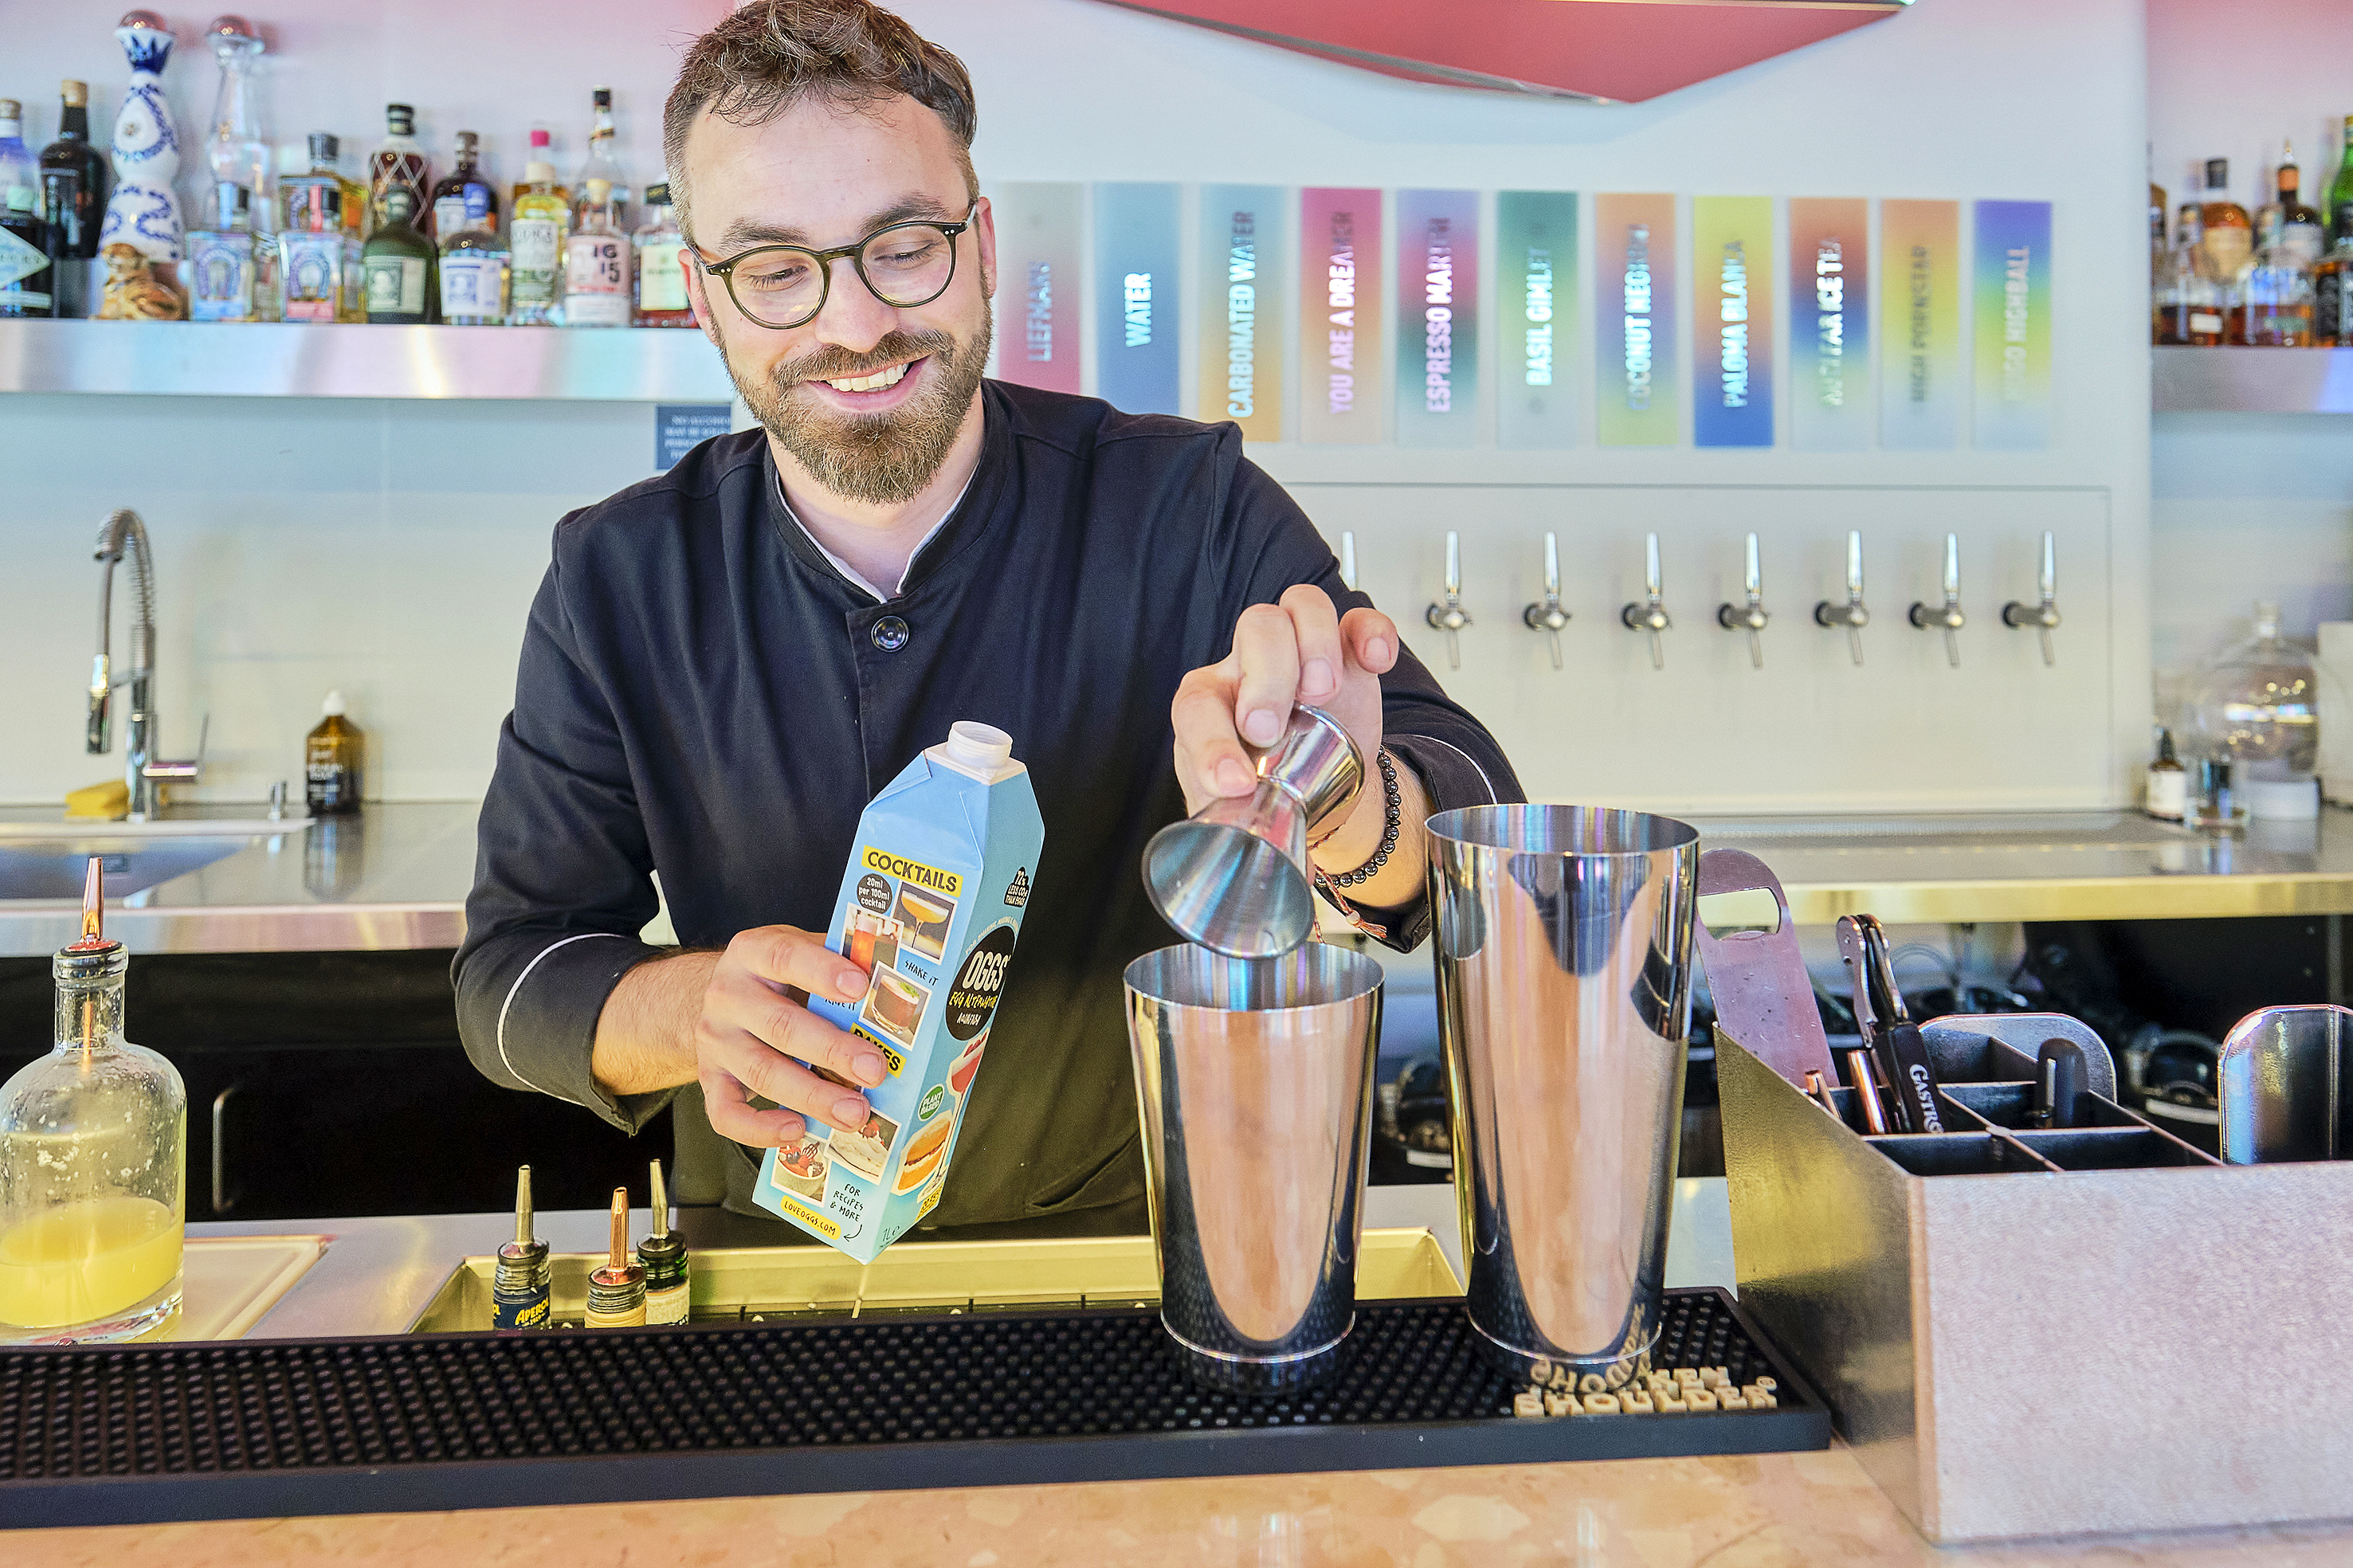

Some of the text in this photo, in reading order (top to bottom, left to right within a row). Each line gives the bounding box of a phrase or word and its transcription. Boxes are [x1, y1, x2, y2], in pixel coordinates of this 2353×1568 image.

[1124, 272, 1152, 347] WATER
[1816, 276, 1844, 312] ICE
[1228, 211, 1257, 417] CARBONATED WATER
[1329, 310, 1355, 327] A
[1525, 246, 1552, 386] BASIL GIMLET
[1329, 329, 1355, 370] ARE
[1426, 306, 1452, 413] ESPRESSO
[1625, 314, 1652, 411] COCONUT
[1721, 323, 1748, 408] PALOMA
[1328, 373, 1355, 414] YOU
[866, 876, 884, 889] 20ml
[868, 851, 957, 892] COCKTAILS
[858, 886, 890, 901] per 100ml
[861, 897, 886, 910] cocktail
[904, 959, 928, 980] SHAKE
[962, 951, 1010, 992] OGGS
[948, 991, 965, 1009] EGG
[920, 1100, 940, 1115] BASED
[922, 1091, 943, 1107] PLANT
[1908, 1064, 1945, 1133] GASTRO
[844, 1183, 861, 1197] FOR
[784, 1201, 836, 1236] LOVEOGGS.COM
[838, 1205, 861, 1222] MORE
